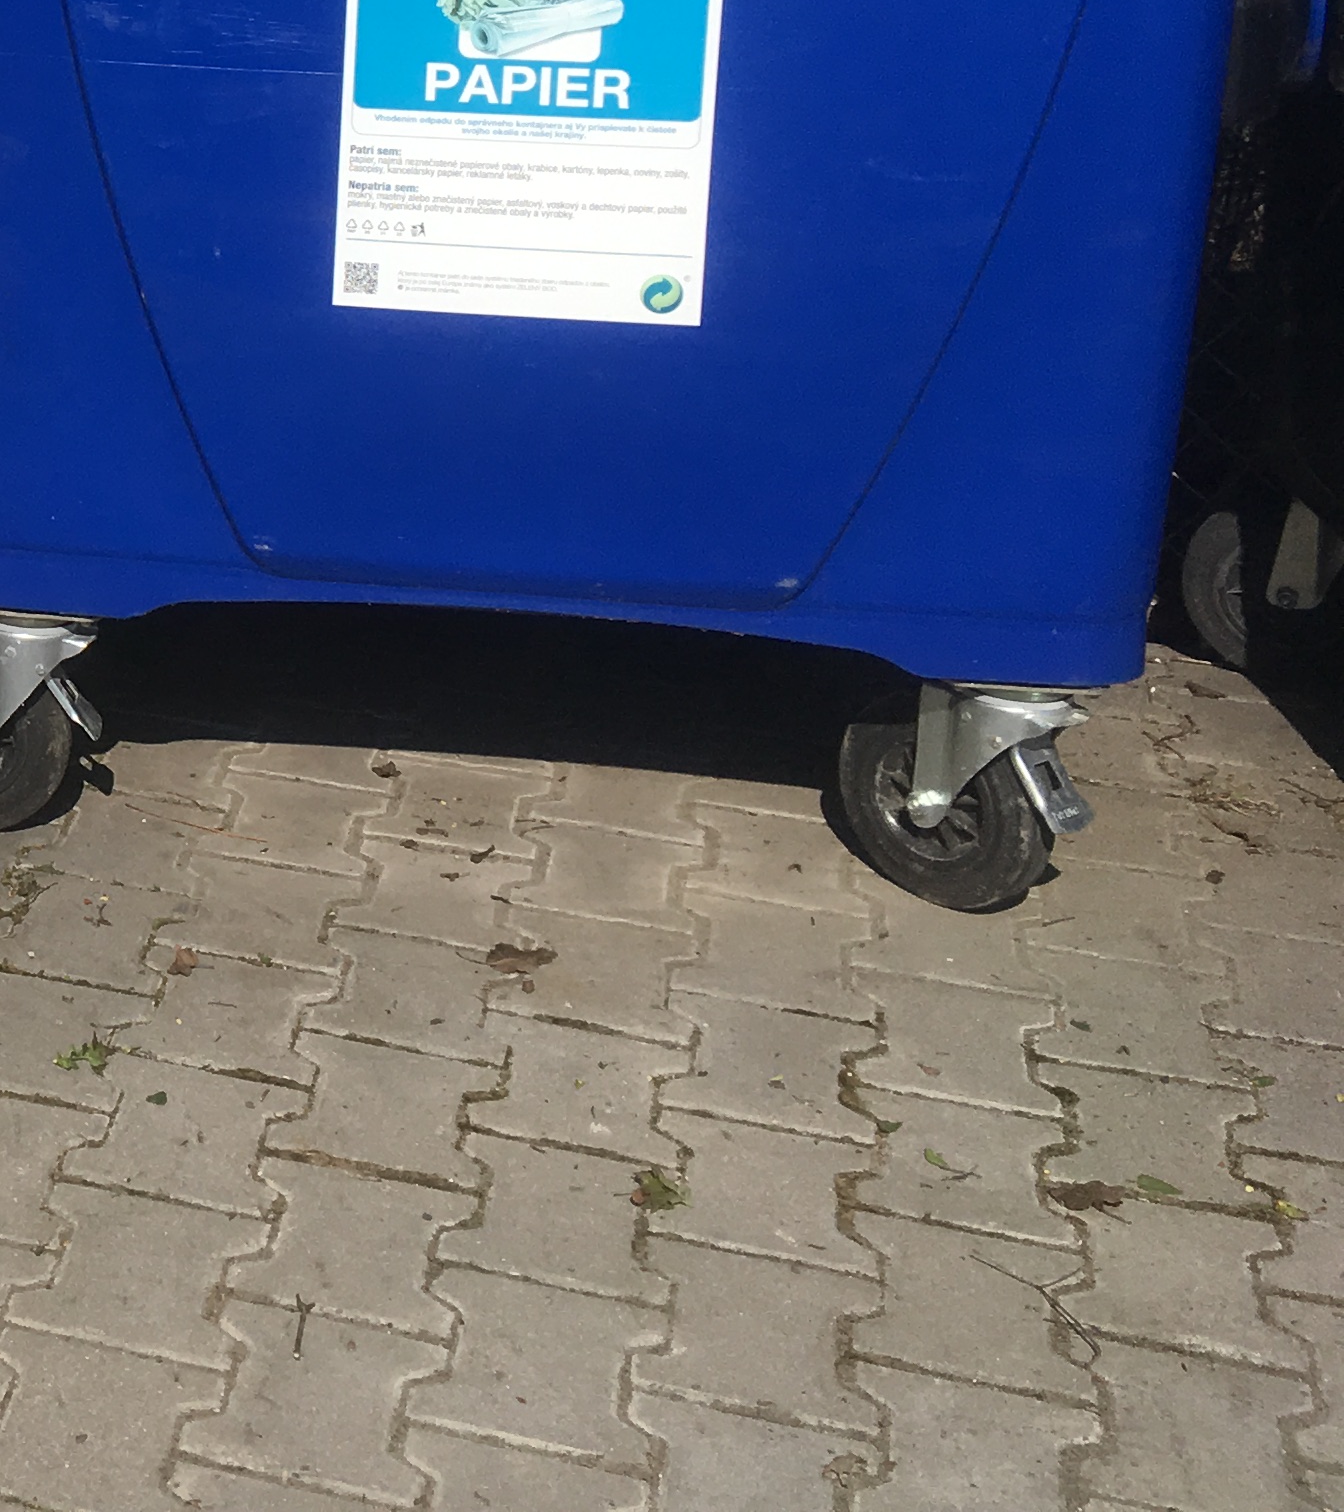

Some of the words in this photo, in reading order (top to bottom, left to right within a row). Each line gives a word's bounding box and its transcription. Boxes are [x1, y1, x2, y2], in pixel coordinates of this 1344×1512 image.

[424, 62, 631, 109] PAPIER
[419, 116, 452, 125] odpadu
[516, 120, 562, 130] kontajnera
[575, 123, 586, 131] Vy
[350, 144, 374, 155] Patrí
[377, 147, 401, 156] sem:
[348, 180, 391, 193] Nepatria
[395, 183, 420, 193] sem:
[408, 193, 430, 203] alebo
